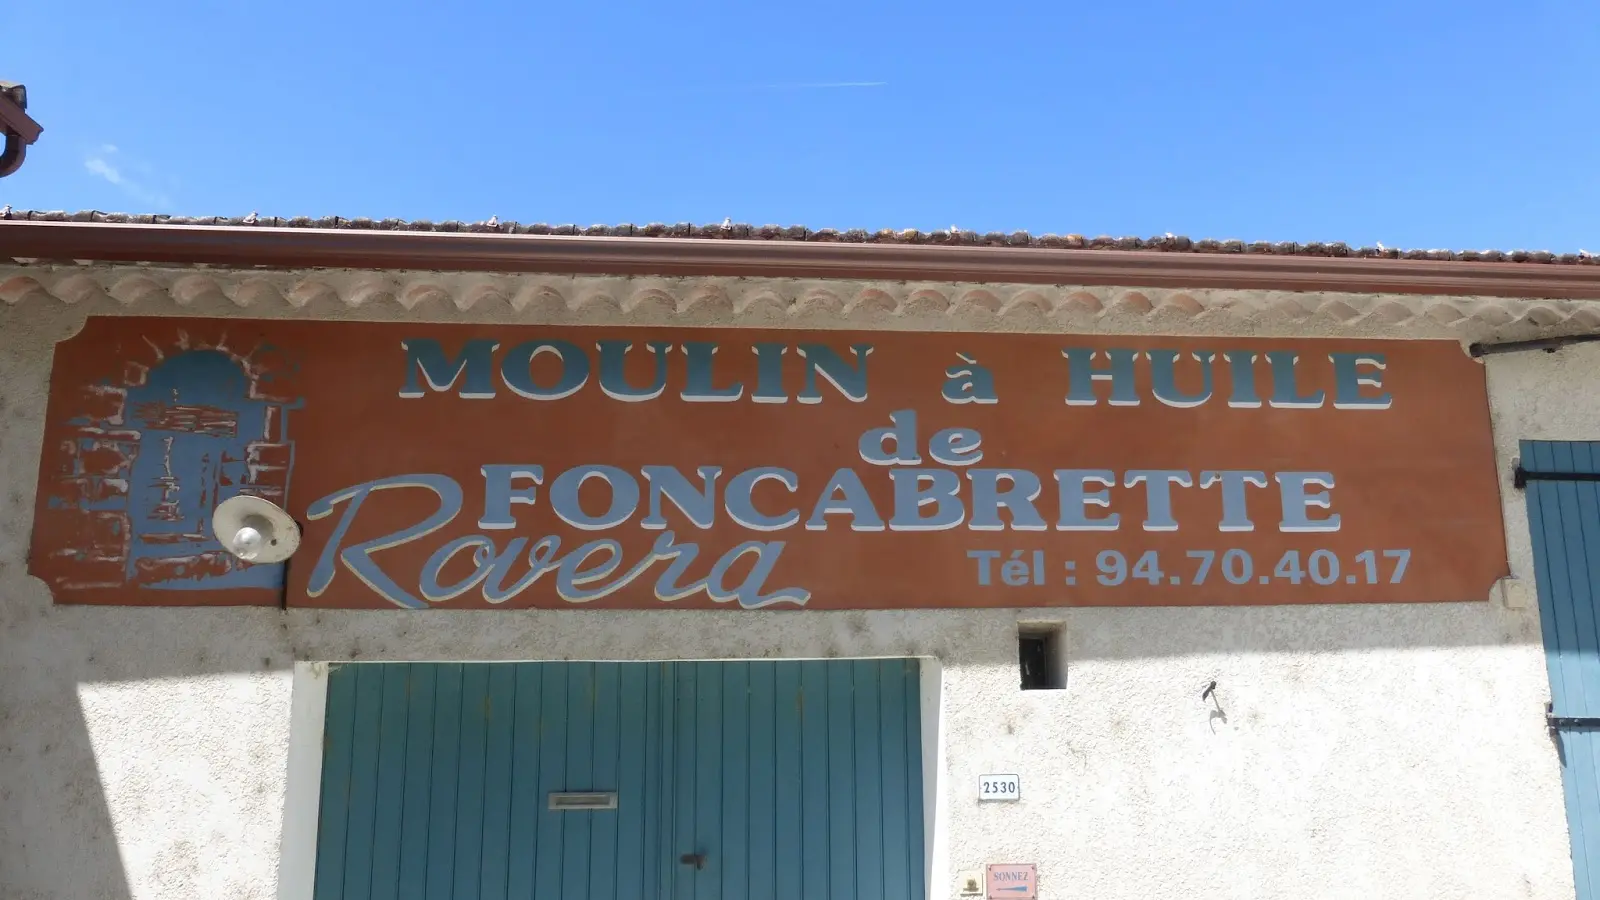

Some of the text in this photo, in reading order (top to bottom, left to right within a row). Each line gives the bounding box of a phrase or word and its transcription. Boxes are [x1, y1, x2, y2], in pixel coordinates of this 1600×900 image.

[398, 338, 1393, 410] MOULIN à HUILE
[858, 409, 984, 466] de
[477, 463, 1341, 533] FONCABRETTE
[306, 473, 811, 610] Rovera
[966, 548, 1412, 587] Tél : 94.70.40.17
[983, 781, 1016, 794] 2530
[993, 871, 1029, 882] SONNEZ
